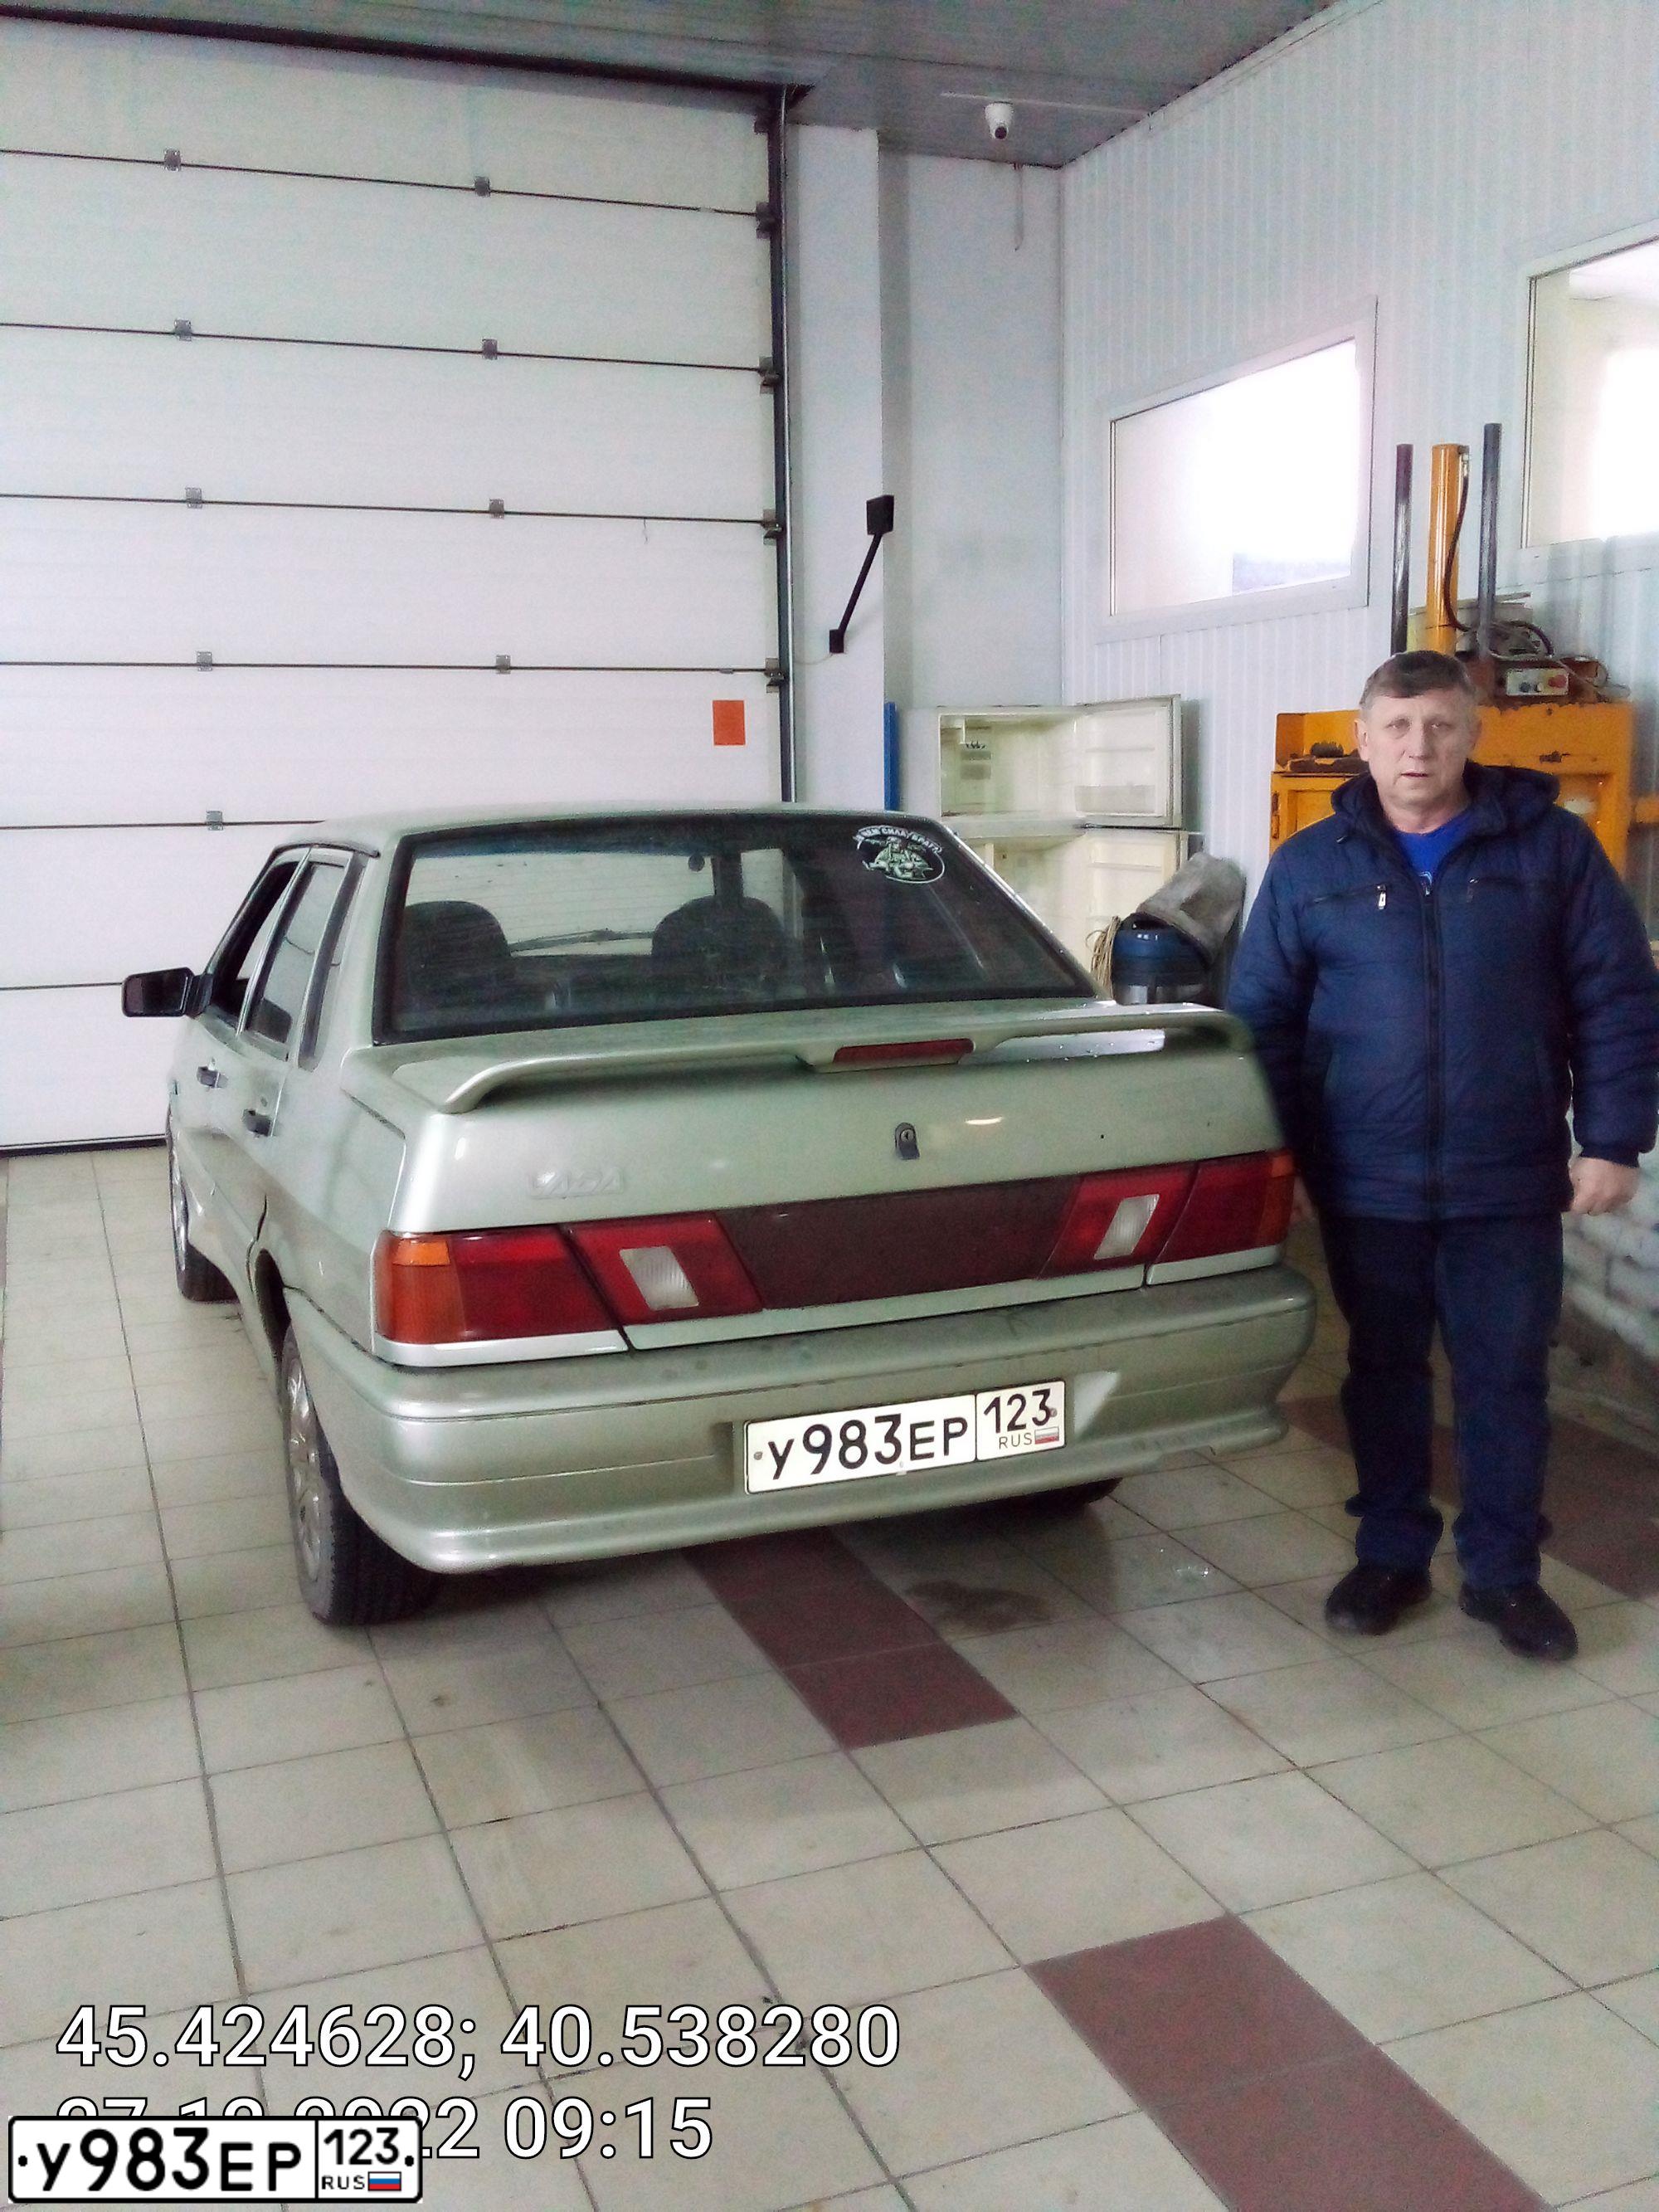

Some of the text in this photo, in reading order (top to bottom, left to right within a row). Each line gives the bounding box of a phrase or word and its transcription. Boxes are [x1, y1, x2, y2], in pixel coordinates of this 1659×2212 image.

[768, 1388, 1052, 1480] У983ЕР 123
[999, 1433, 1033, 1450] RUS
